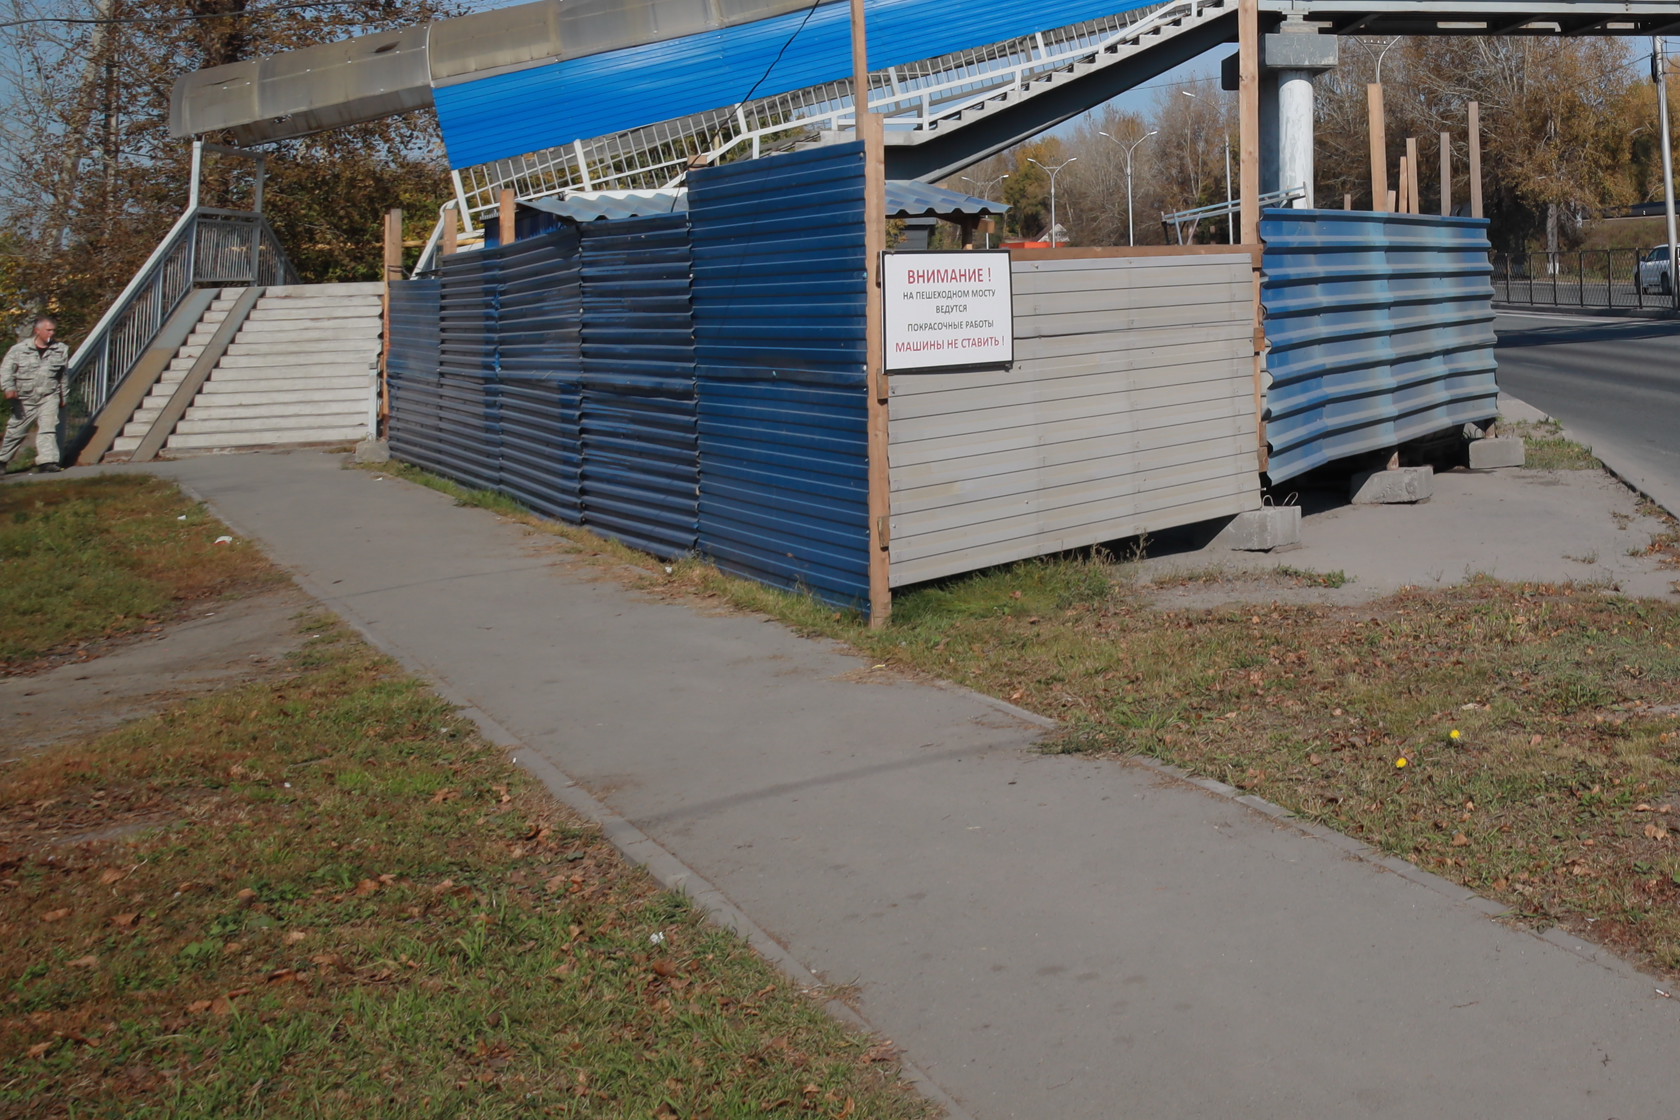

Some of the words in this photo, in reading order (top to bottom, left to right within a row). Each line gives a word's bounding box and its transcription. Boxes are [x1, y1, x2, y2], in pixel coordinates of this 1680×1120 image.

[907, 268, 984, 284] ВНИМАНИЕ
[903, 291, 914, 300] НА
[916, 290, 970, 300] ПЕШЕХОДНОМ
[971, 289, 996, 298] МОСТУ
[935, 304, 968, 314] ВЕДУТСЯ
[907, 321, 963, 332] ПОКРАСОЧНЫЕ
[965, 319, 994, 329] РАБОТЫ
[895, 339, 945, 352] МАШИНЫ
[947, 338, 959, 349] НЕ
[961, 336, 1000, 349] СТАВИТЬ
